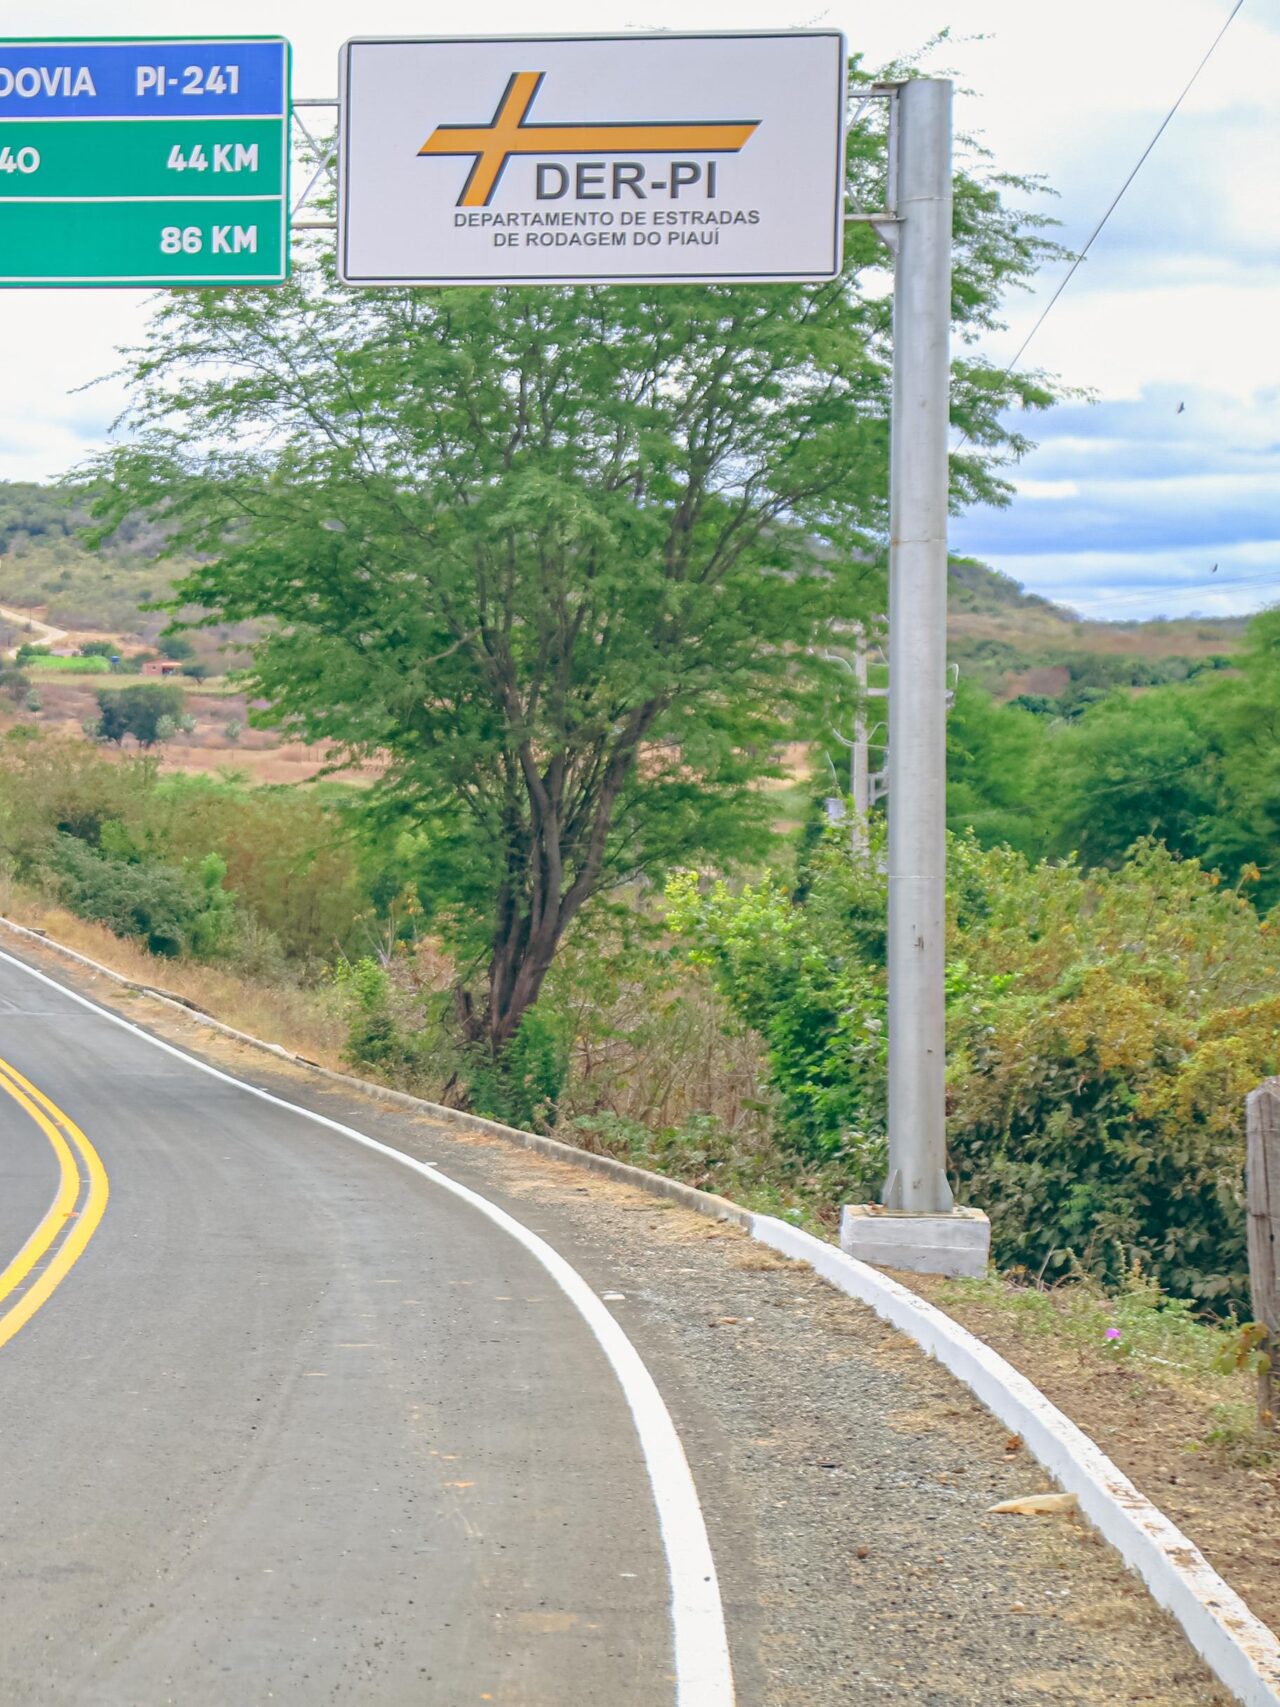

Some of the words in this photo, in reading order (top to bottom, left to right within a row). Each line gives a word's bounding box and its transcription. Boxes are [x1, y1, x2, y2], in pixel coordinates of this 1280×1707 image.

[136, 65, 240, 97] PI-241
[535, 160, 717, 200] DER-PI
[454, 212, 614, 227] DEPARTAMENTO
[621, 212, 648, 226] DE
[653, 210, 761, 226] ESTRADAS
[160, 227, 202, 254] 86
[212, 226, 258, 253] KM
[493, 233, 519, 247] DE
[526, 231, 626, 247] RODAGEM
[633, 231, 662, 246] DO
[670, 227, 719, 246] PIAUÍ
